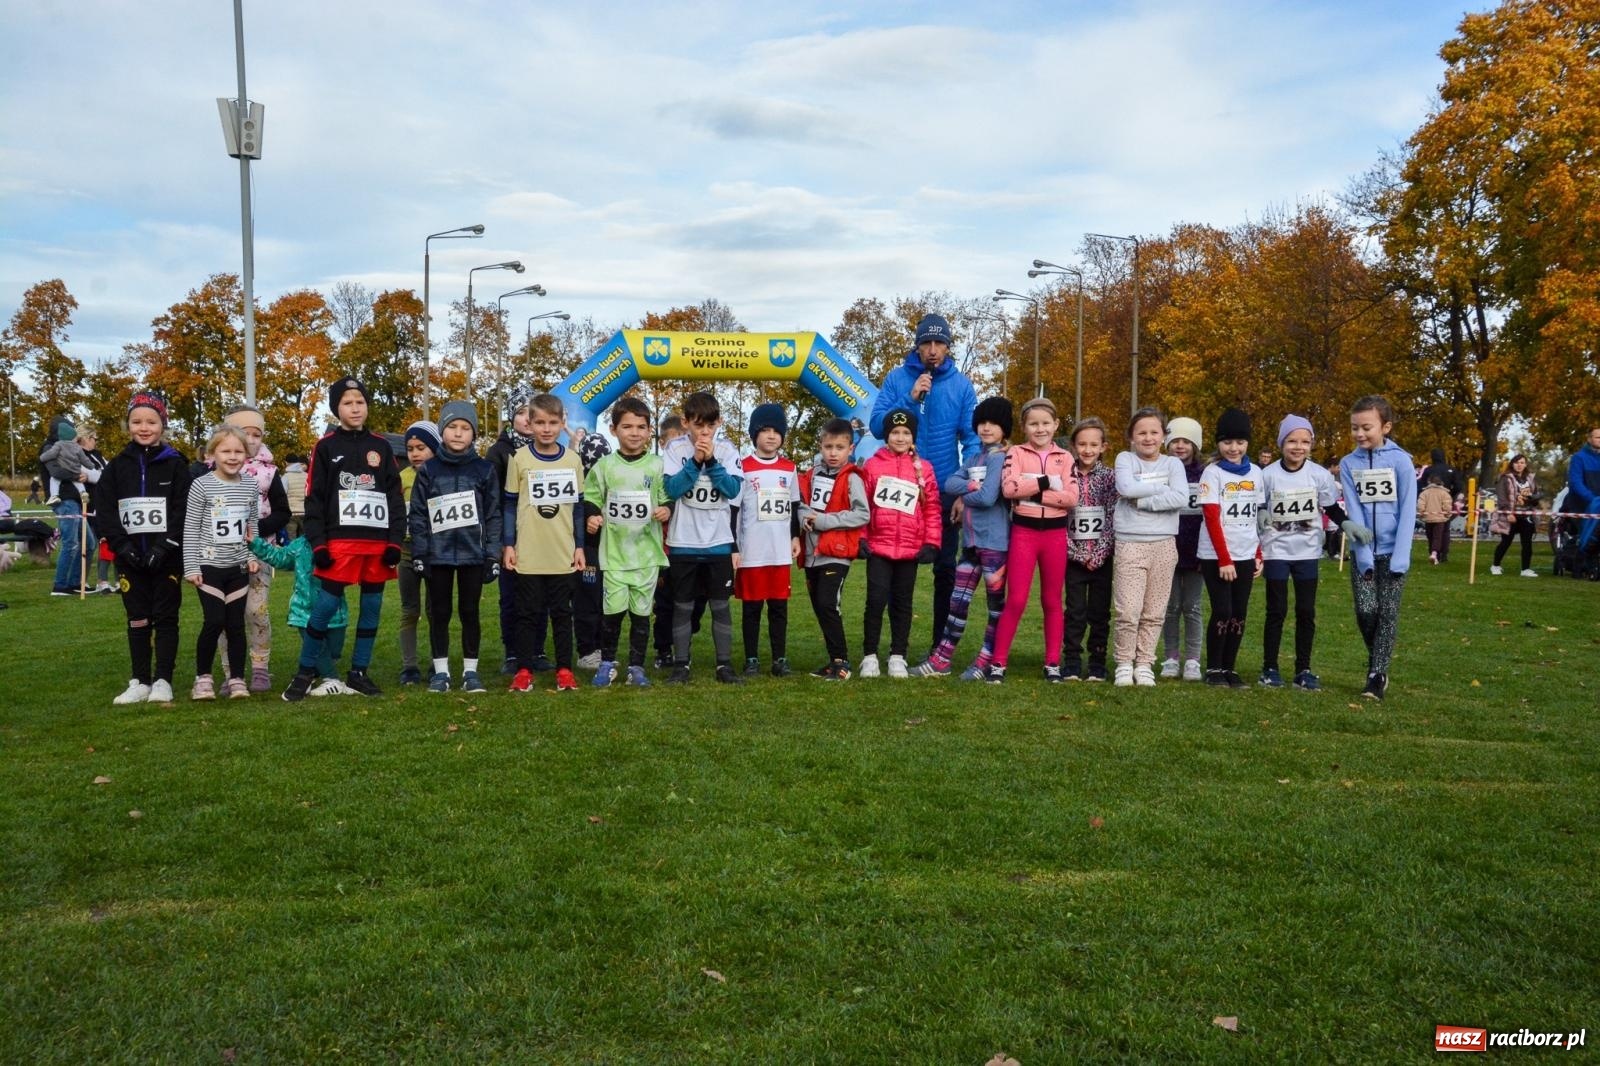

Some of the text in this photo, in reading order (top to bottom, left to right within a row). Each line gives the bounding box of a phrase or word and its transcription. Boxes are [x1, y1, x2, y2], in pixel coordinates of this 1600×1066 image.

[694, 337, 746, 347] Gmina
[681, 347, 759, 358] Pietrowice
[569, 346, 624, 395] Gmina ludzi
[691, 358, 749, 370] Wielkie
[581, 358, 632, 404] aktywnych
[815, 350, 870, 400] Gmina ludzi
[807, 361, 858, 409] aktywnych
[532, 480, 576, 499] 554
[812, 488, 832, 505] 50
[876, 486, 916, 508] 447
[1355, 480, 1394, 497] 453
[342, 502, 386, 521] 440
[432, 503, 475, 525] 448
[608, 502, 649, 519] 539
[760, 499, 791, 515] 454
[1226, 502, 1257, 518] 449
[1273, 498, 1316, 516] 444
[122, 509, 163, 528] 436
[216, 517, 249, 537] 51
[1069, 517, 1103, 534] 452
